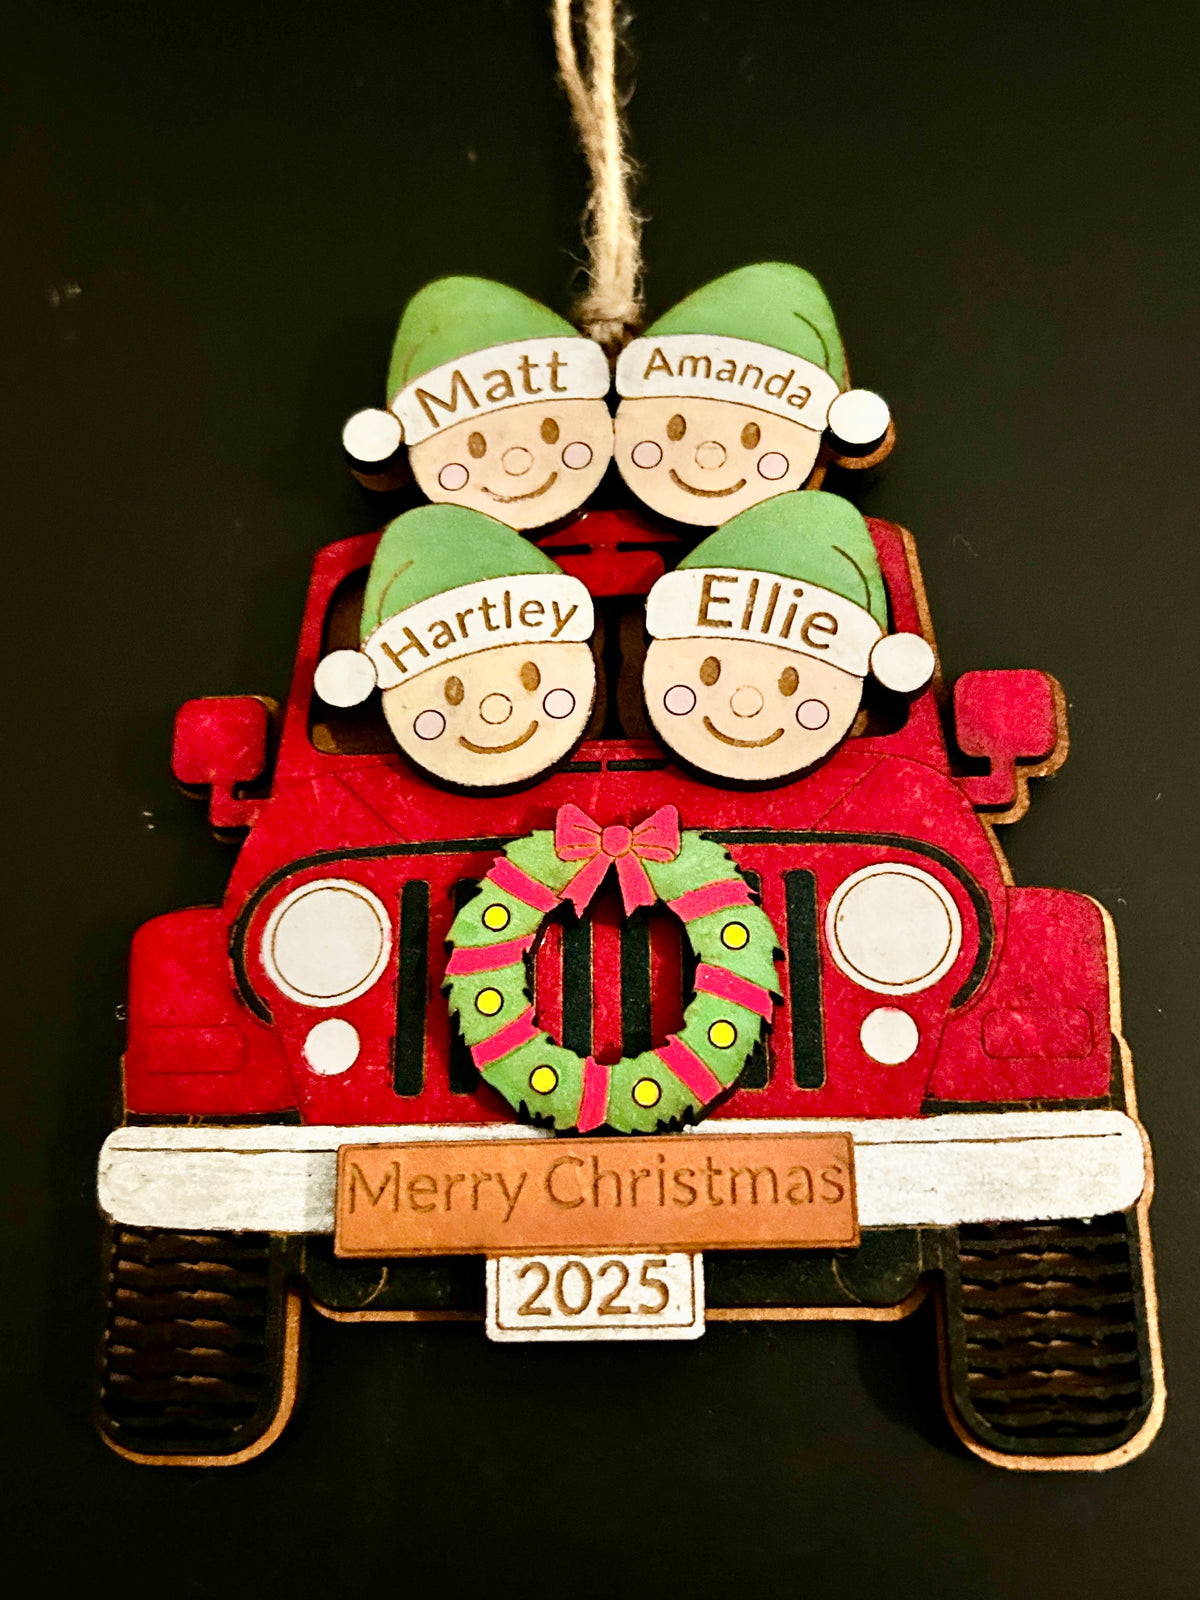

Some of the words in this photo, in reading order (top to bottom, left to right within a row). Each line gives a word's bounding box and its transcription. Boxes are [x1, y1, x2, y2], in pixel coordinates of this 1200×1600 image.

[415, 351, 567, 428] Matt
[643, 347, 813, 410] Amanda
[380, 590, 578, 674] Hartley
[697, 574, 838, 650] Ellie
[348, 1161, 527, 1222] Merry
[544, 1153, 845, 1210] Christmas
[517, 1258, 670, 1317] 2025
